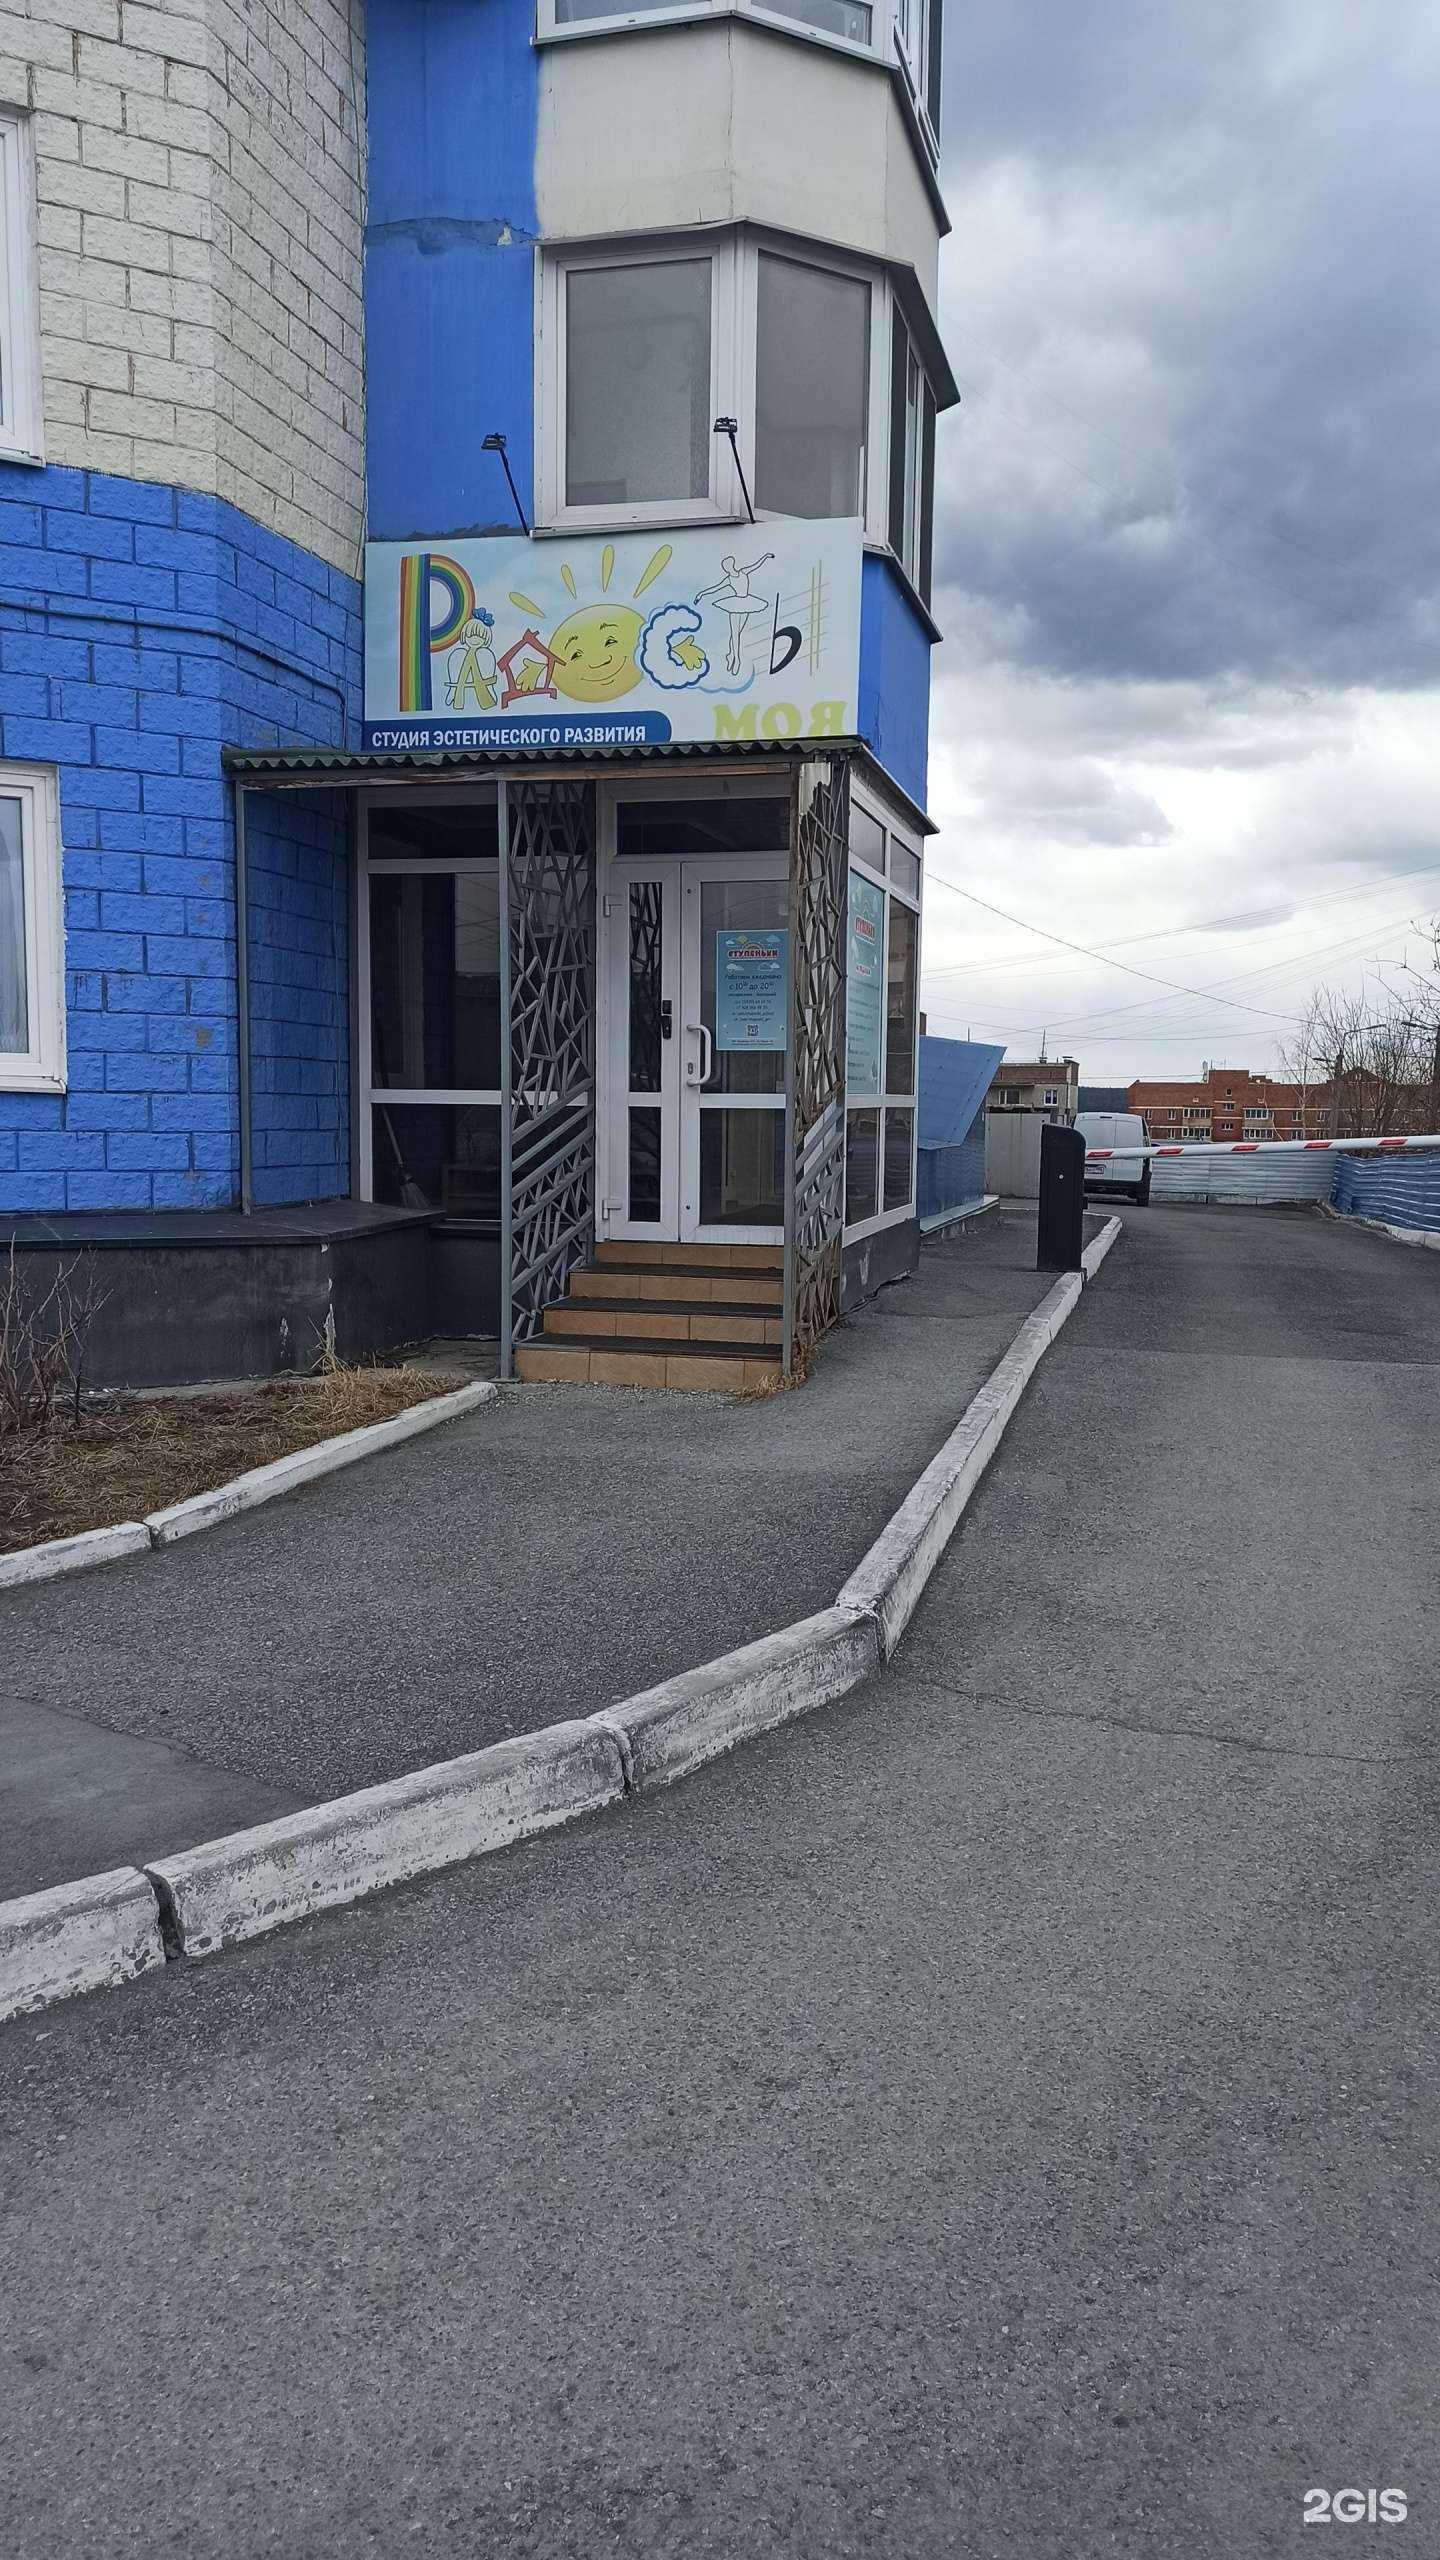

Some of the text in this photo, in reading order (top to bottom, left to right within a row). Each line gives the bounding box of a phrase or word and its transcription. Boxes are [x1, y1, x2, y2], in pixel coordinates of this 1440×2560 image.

[713, 701, 847, 740] МОЯ
[372, 726, 646, 749] СТУДИЯ ЭСТЕТИЧЕСКОГО РАЗВИТИЯ
